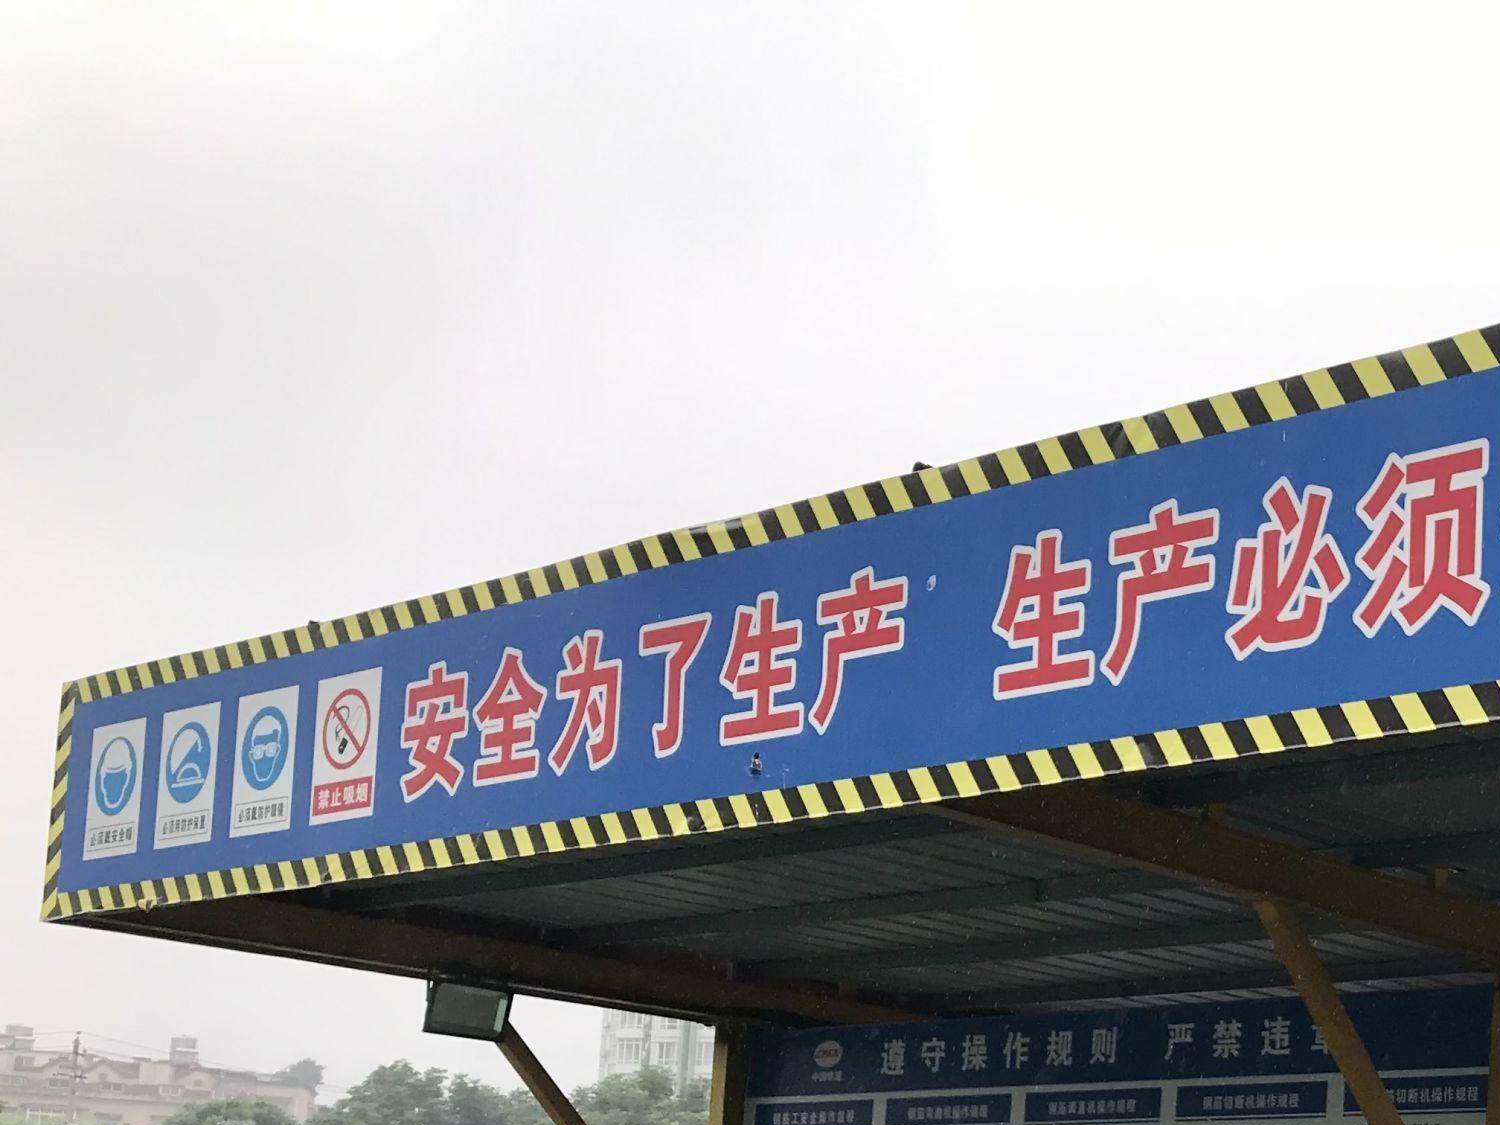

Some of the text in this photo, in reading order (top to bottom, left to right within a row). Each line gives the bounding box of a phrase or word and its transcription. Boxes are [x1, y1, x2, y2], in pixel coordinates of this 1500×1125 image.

[401, 566, 908, 802] 安全为了生产
[318, 783, 367, 809] 禁止吸烟
[90, 827, 133, 847] 必须戴安全帽
[880, 1027, 1117, 1076] 遵守操作规则
